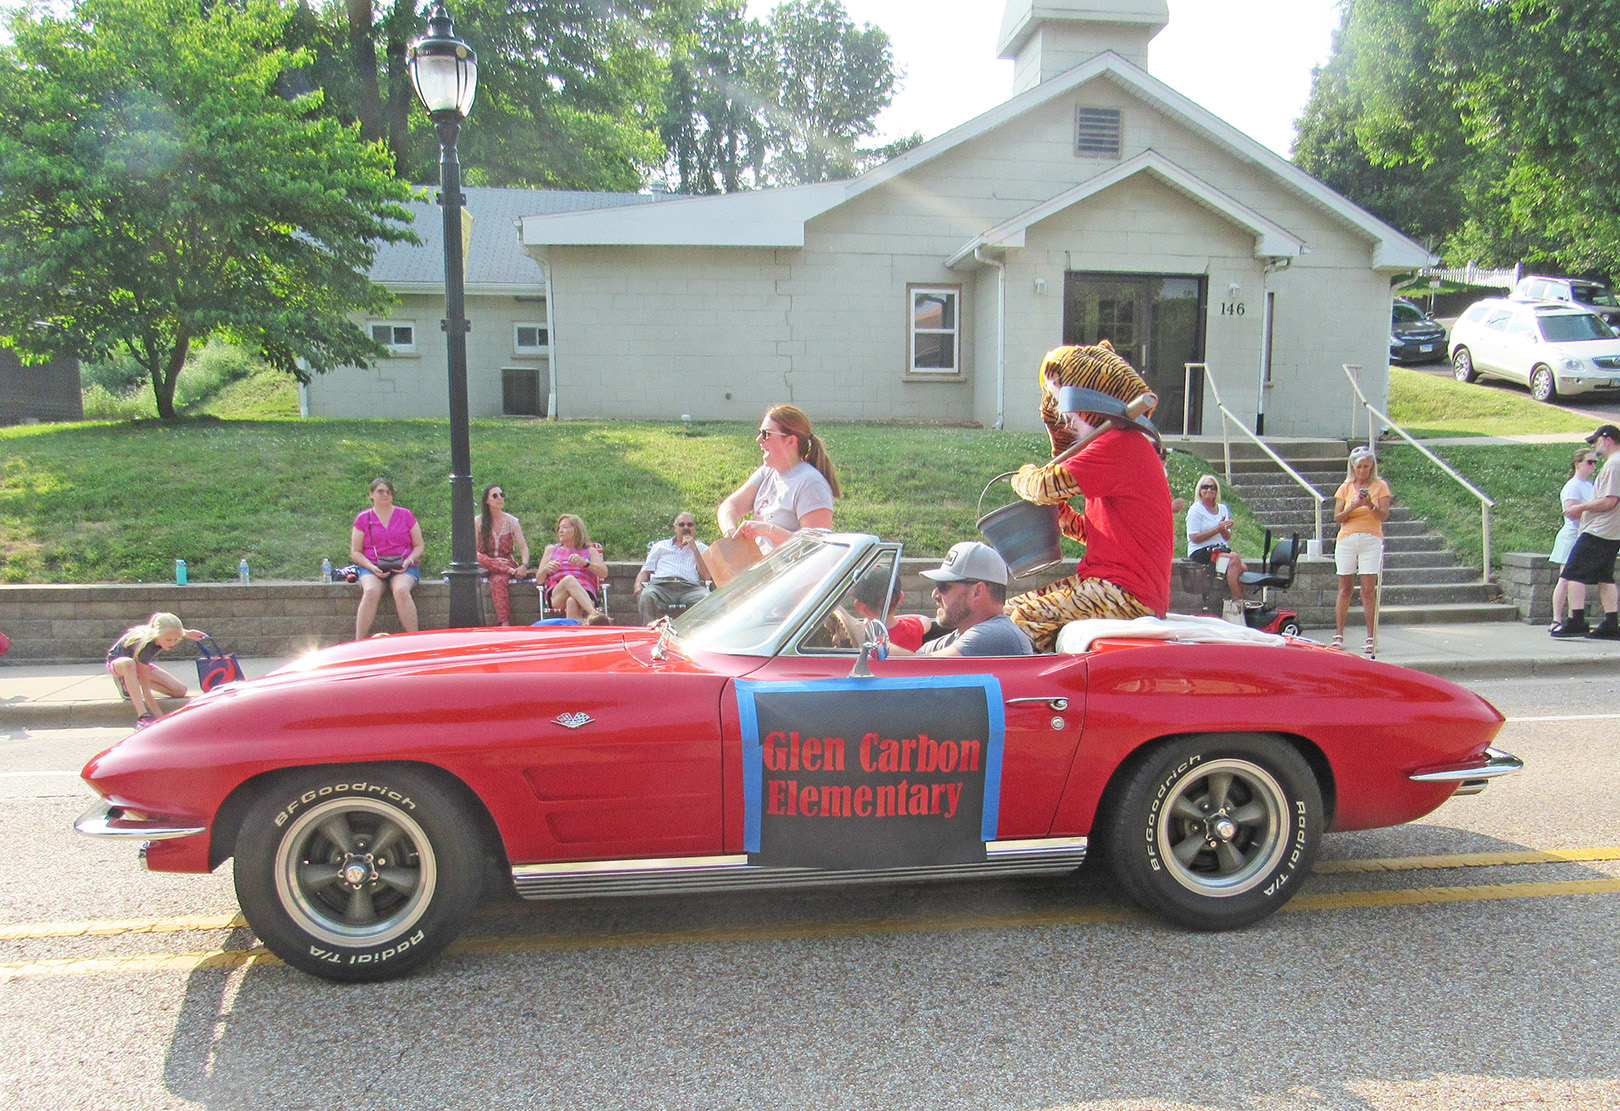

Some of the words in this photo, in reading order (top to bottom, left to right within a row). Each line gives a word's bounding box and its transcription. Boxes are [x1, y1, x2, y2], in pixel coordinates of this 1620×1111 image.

[1220, 302, 1246, 316] 146
[762, 730, 846, 771] Glen
[859, 732, 981, 772] Carbon
[274, 782, 416, 828] BFGoodrich
[766, 778, 963, 818] Elementary
[1145, 754, 1201, 871] BFGoodrich
[1287, 800, 1306, 870] Radial
[1263, 873, 1289, 896] T/A
[309, 944, 342, 964] T/A
[350, 929, 425, 965] Radial
